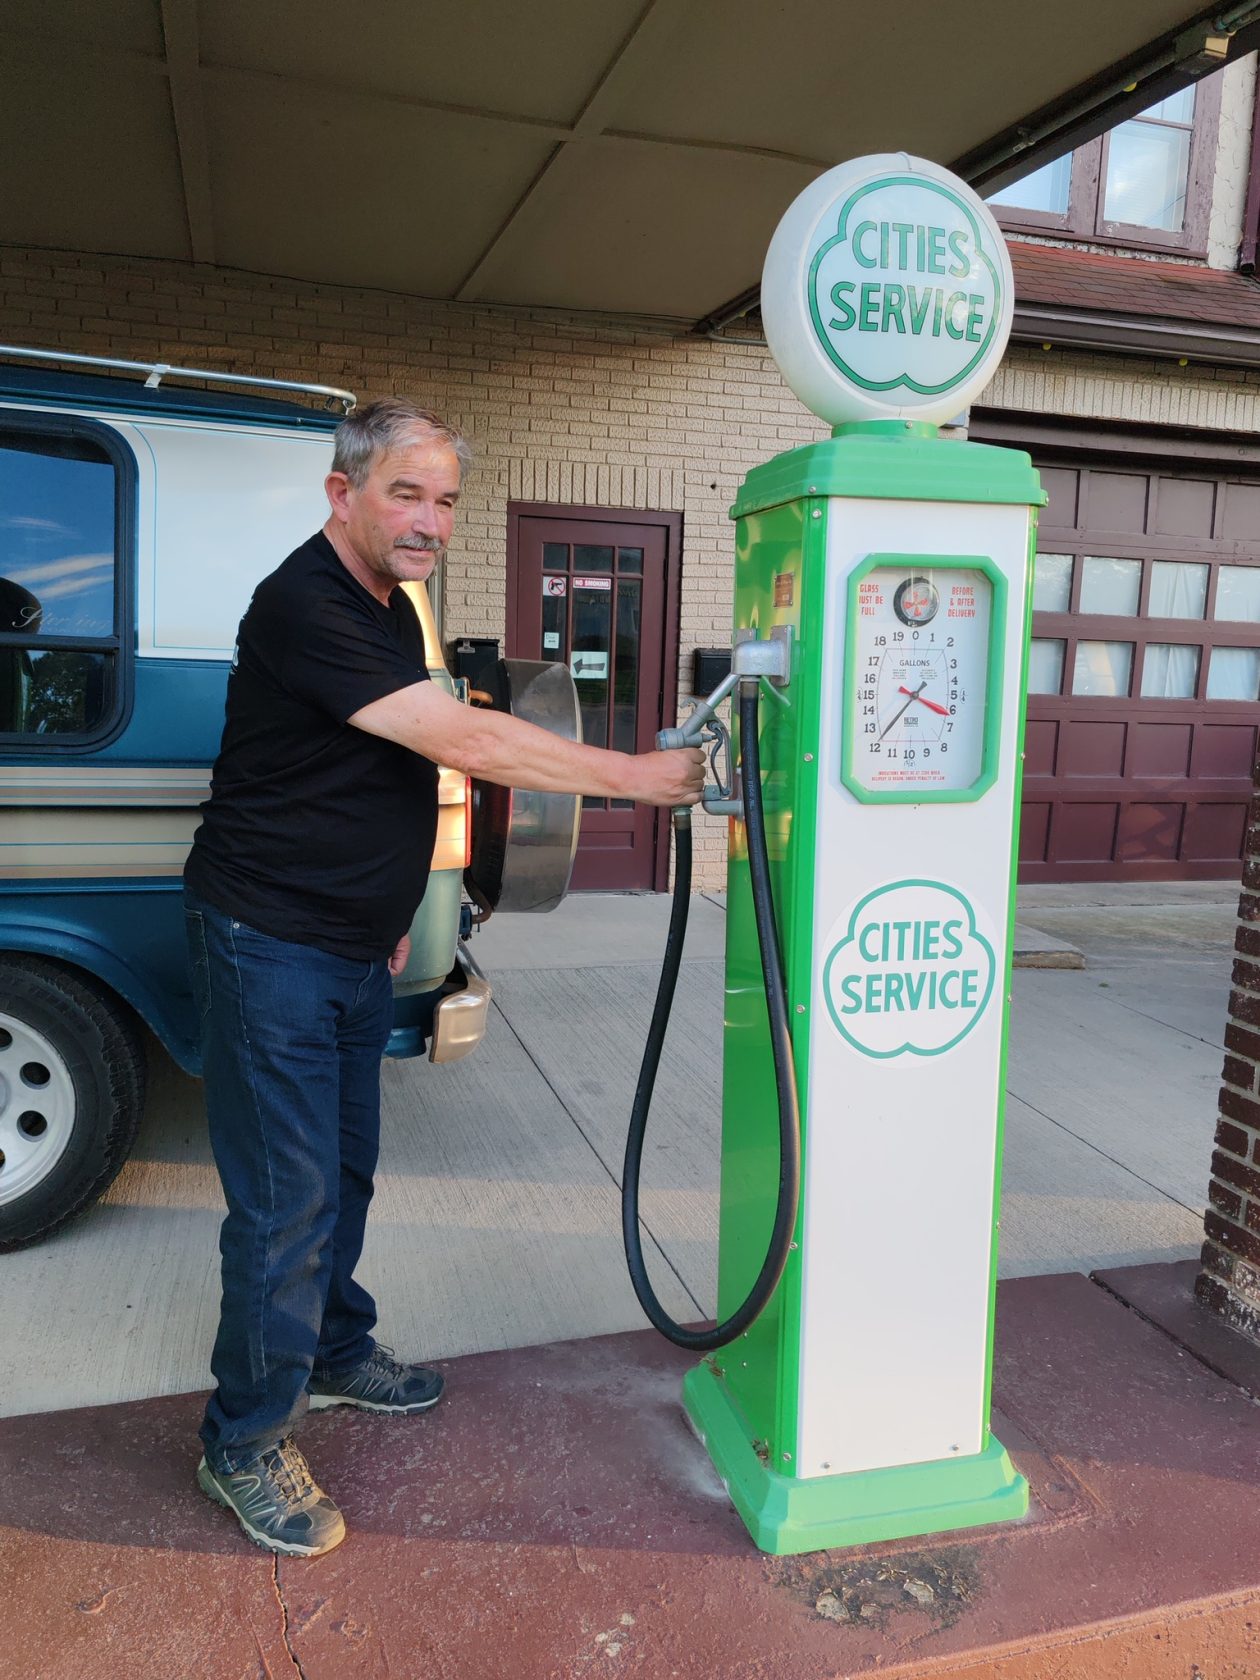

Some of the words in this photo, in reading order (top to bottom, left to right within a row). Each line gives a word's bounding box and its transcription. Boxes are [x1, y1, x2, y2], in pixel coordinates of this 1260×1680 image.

[852, 220, 970, 278] CITIES
[828, 281, 984, 342] SERVICE
[859, 584, 880, 593] GLASS
[952, 586, 974, 596] BEFORE
[875, 596, 884, 604] BE
[957, 598, 975, 607] AFTER
[861, 607, 875, 616] FULL
[947, 609, 976, 618] DELIVERY
[892, 631, 904, 641] 19
[912, 630, 919, 640] 0
[930, 633, 935, 642] 1
[874, 636, 886, 646] 18
[946, 637, 954, 647] 2
[868, 656, 880, 666] 17
[950, 659, 957, 669] 3
[864, 674, 876, 683] 16
[951, 676, 958, 685] 4
[863, 690, 875, 700] 15
[950, 690, 958, 700] 5
[863, 706, 874, 715] 14
[949, 705, 957, 715] 6
[864, 723, 876, 733] 13
[947, 723, 954, 732] 7
[869, 743, 881, 752] 12
[940, 742, 948, 752] 8
[887, 748, 897, 758] 11
[903, 750, 915, 759] 10
[923, 748, 930, 757] 9
[859, 920, 963, 963] CITIES
[840, 969, 978, 1014] SERVICE
